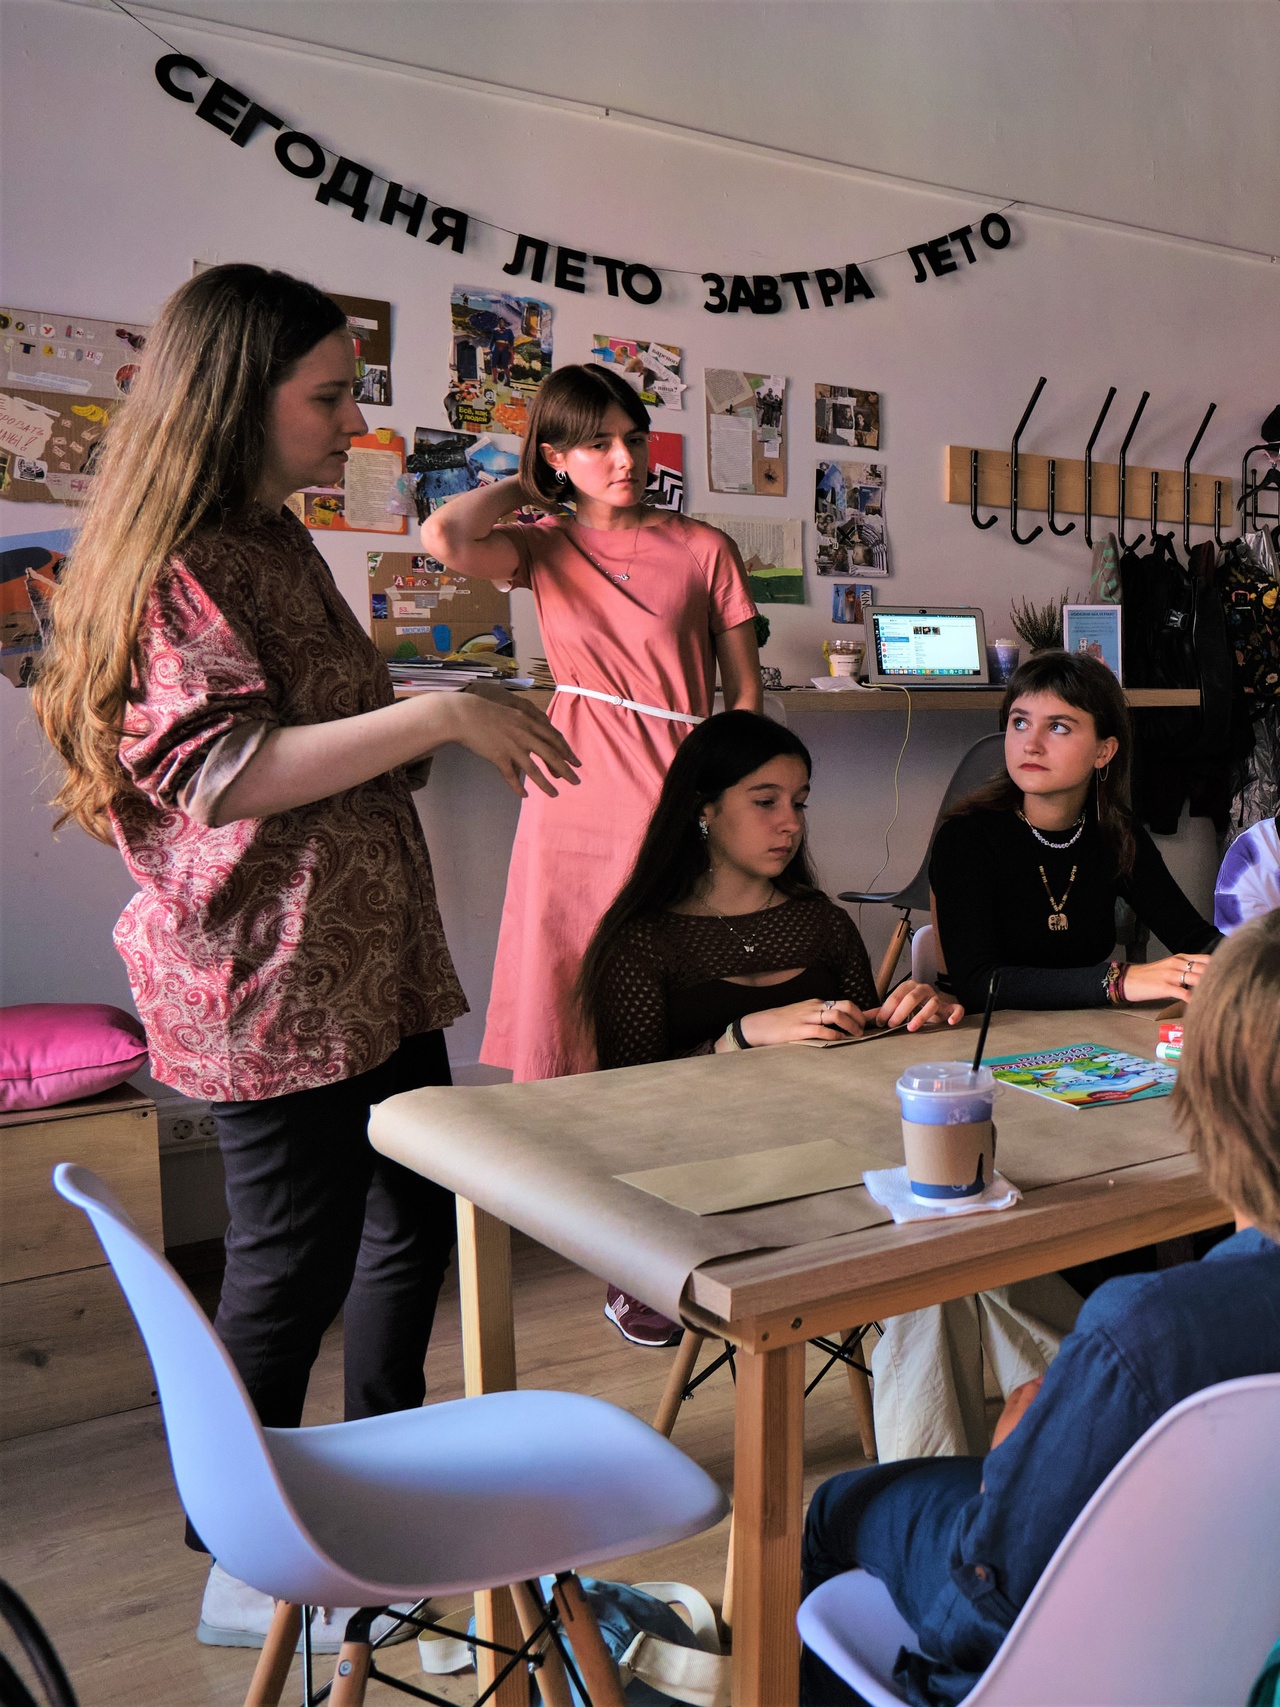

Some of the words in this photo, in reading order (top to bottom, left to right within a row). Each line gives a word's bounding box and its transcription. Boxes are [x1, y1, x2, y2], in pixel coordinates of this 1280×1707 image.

[155, 53, 469, 254] СЕГОДНЯ
[503, 233, 662, 305] ЛЕТО
[701, 263, 875, 314] ЗАВТРА
[907, 213, 1011, 284] ЛЕТО
